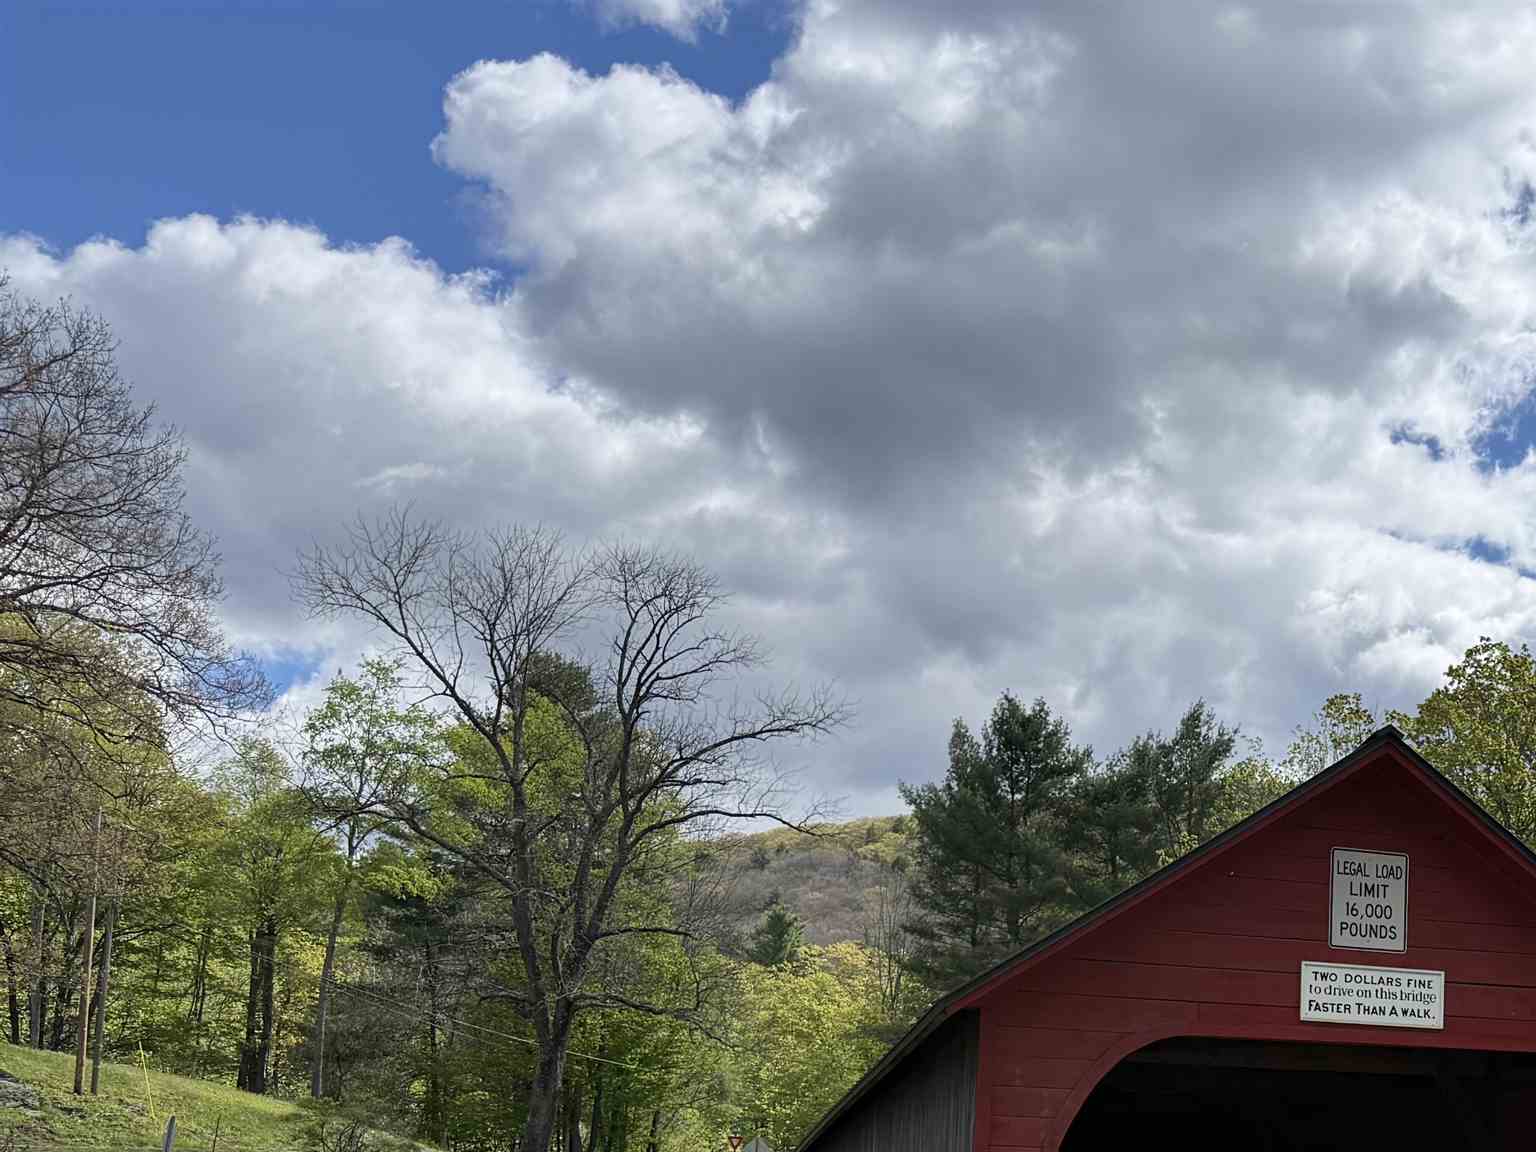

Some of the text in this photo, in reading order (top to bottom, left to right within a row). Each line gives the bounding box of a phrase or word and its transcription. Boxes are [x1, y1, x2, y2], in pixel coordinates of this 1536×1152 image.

[1336, 860, 1403, 880] LEGAL LOAD
[1349, 882, 1390, 899] LIMIT
[1345, 901, 1393, 920] 16,000
[1339, 922, 1397, 940] POUNDS
[1312, 971, 1433, 989] TWO DOLLARS FINE
[1309, 984, 1437, 1005] to drive on this bridge
[1308, 999, 1436, 1019] FASTER THAN A WALK.
